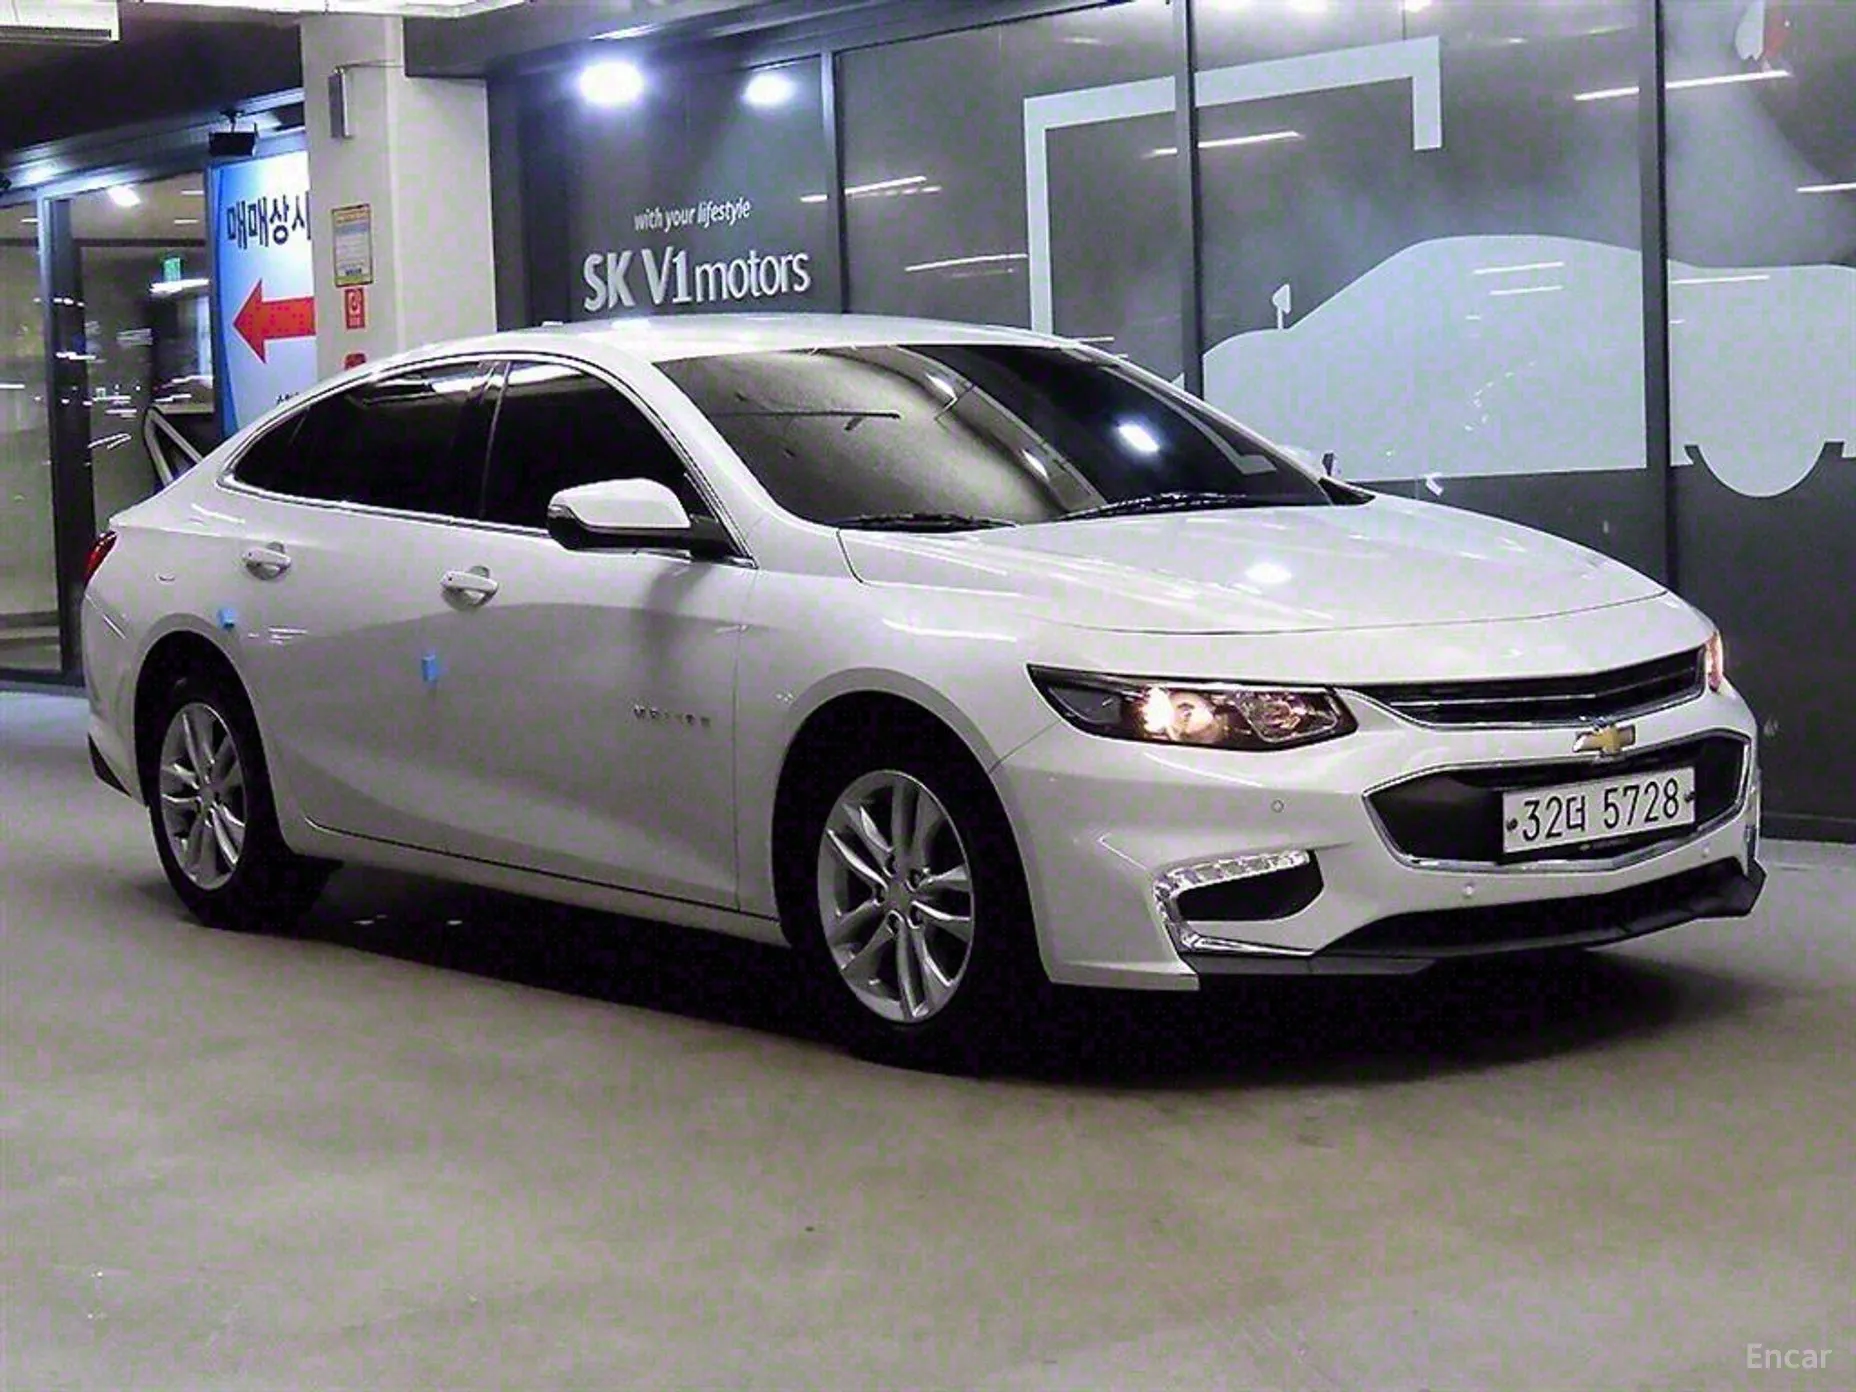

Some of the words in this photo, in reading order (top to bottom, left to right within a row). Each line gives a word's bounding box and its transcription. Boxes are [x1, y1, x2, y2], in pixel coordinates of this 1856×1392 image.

[633, 207, 662, 231] with
[662, 207, 696, 233] your
[697, 196, 751, 229] lifestyle
[583, 251, 636, 312] SK
[1522, 795, 1586, 842] 32더
[1603, 777, 1679, 830] 5728
